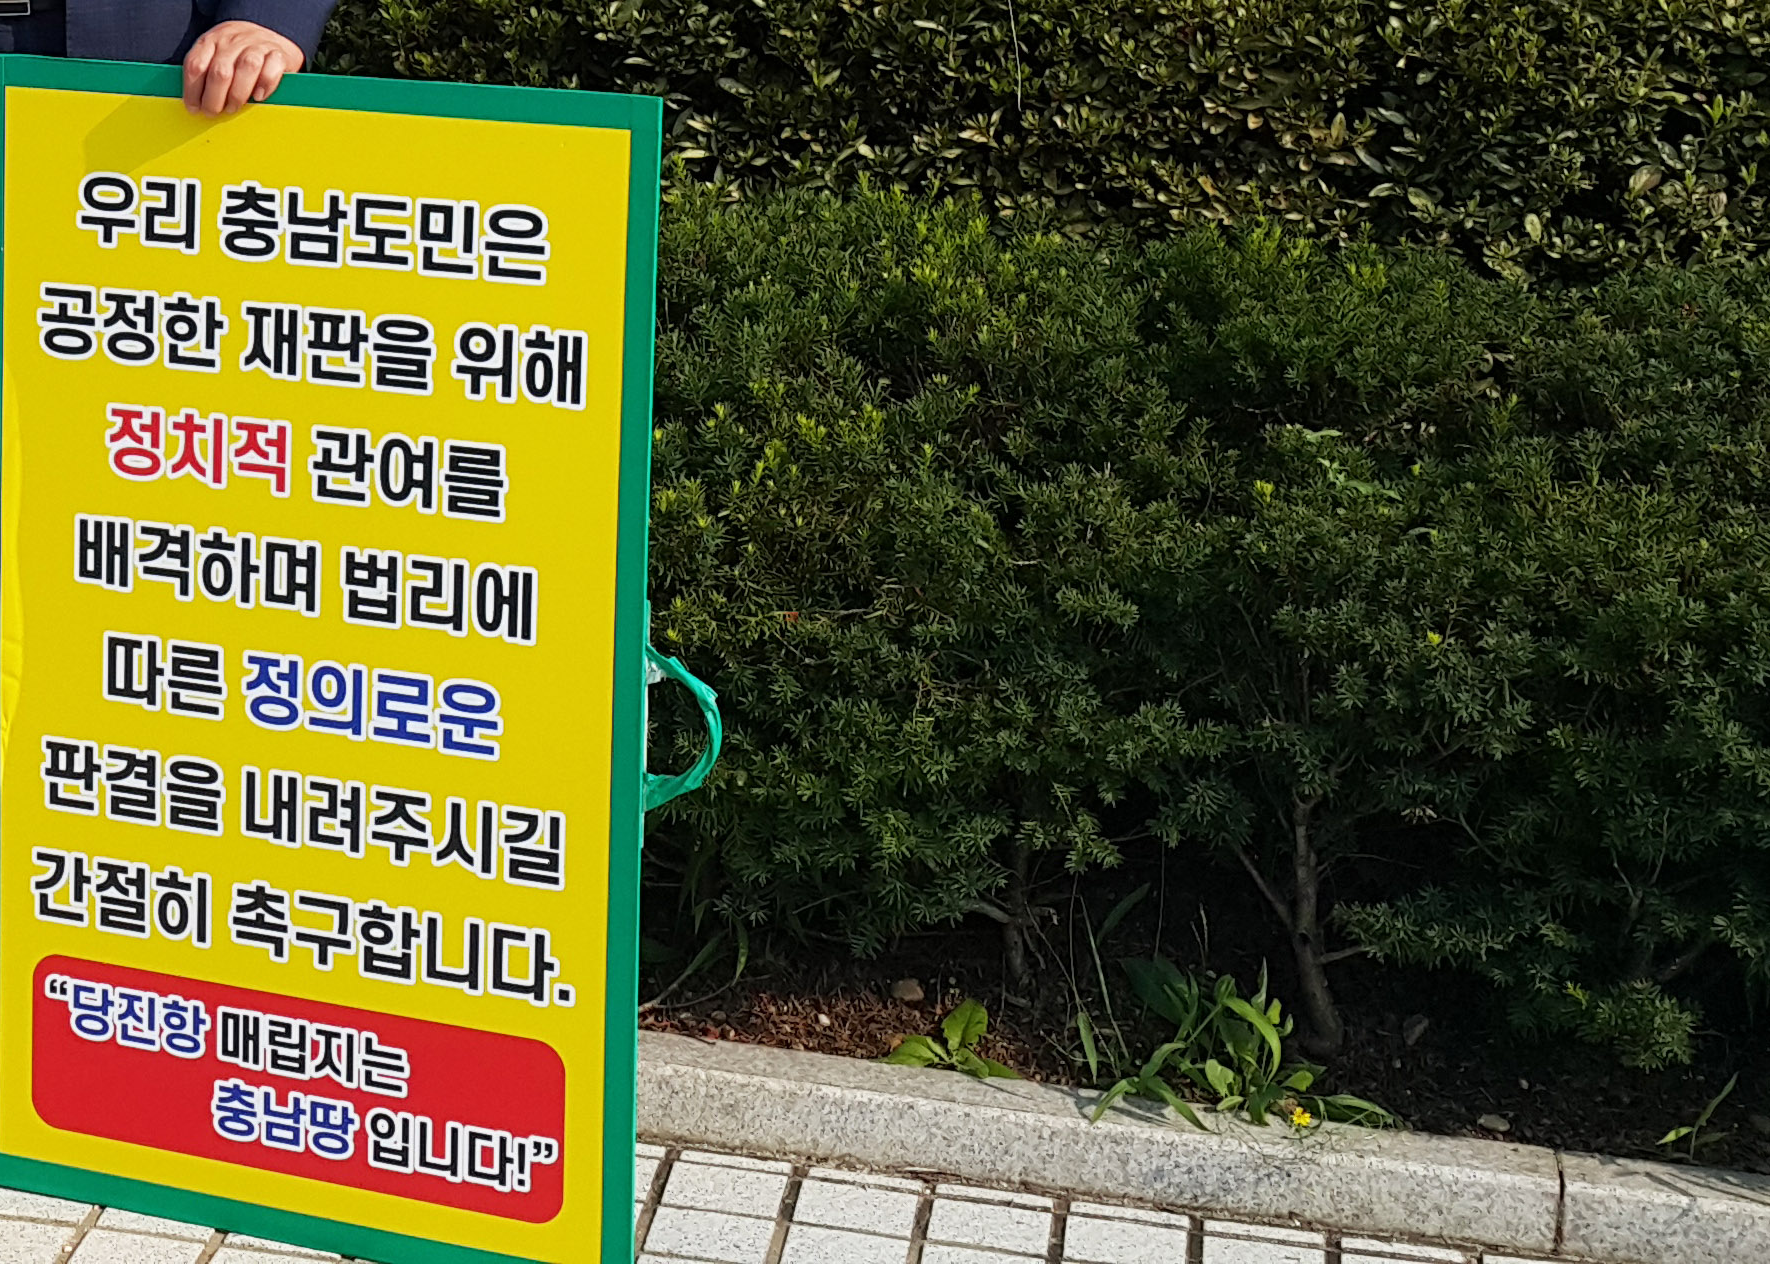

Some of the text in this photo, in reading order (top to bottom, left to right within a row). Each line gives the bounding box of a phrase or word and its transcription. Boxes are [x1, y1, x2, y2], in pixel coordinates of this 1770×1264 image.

[80, 175, 547, 282] 우리 충남도민은
[40, 286, 584, 406] 공정한 재판을 위해
[108, 408, 505, 519] 정치적 관여를
[77, 517, 534, 642] 배격하며 법리에
[106, 635, 499, 757] 따른 정의로운
[43, 739, 562, 887] 판결을 내려주시길
[33, 850, 571, 1003] 간절히 촉구합니다.
[48, 977, 406, 1093] “당진항 매립지는
[214, 1082, 554, 1188] 충남땅 입니다!”
